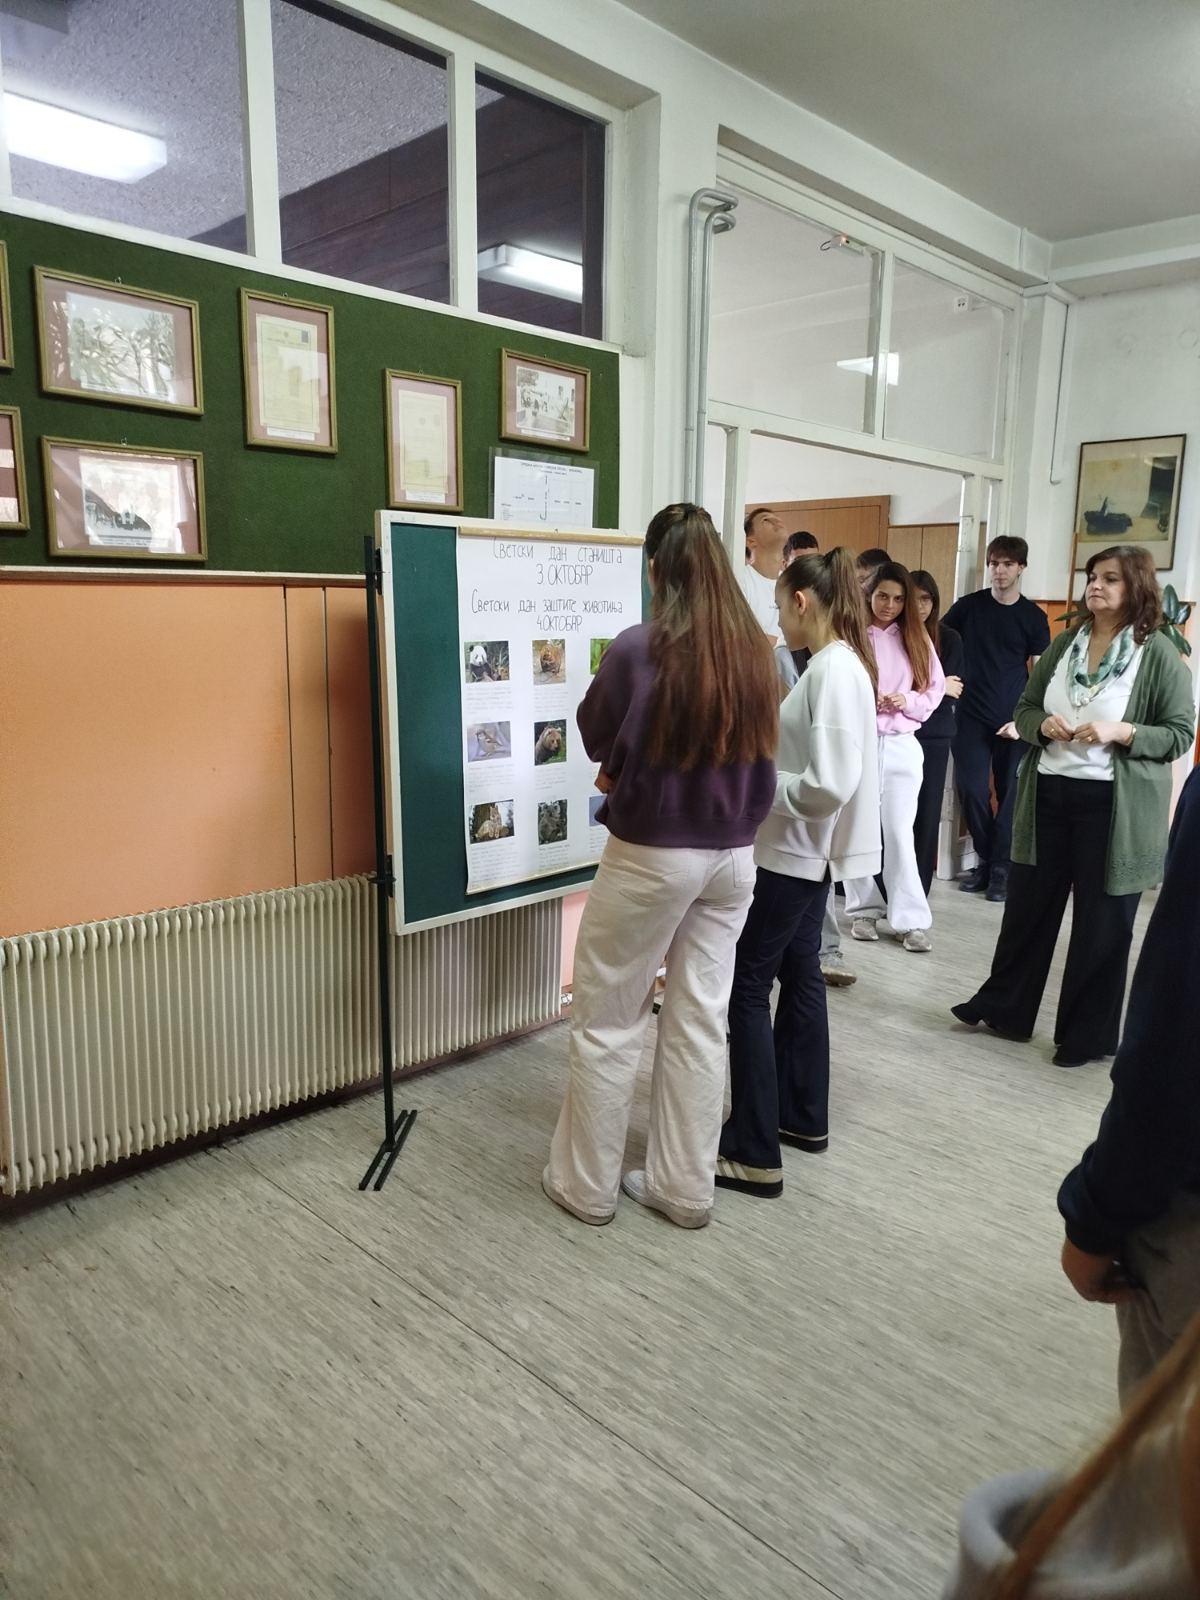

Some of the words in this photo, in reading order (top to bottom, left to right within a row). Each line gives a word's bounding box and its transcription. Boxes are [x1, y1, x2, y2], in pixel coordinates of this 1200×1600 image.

[548, 545, 568, 562] дан
[577, 547, 623, 564] станишта
[471, 589, 510, 614] Светски
[518, 599, 536, 614] дан
[543, 598, 577, 613] заштите
[582, 600, 623, 614] животиња
